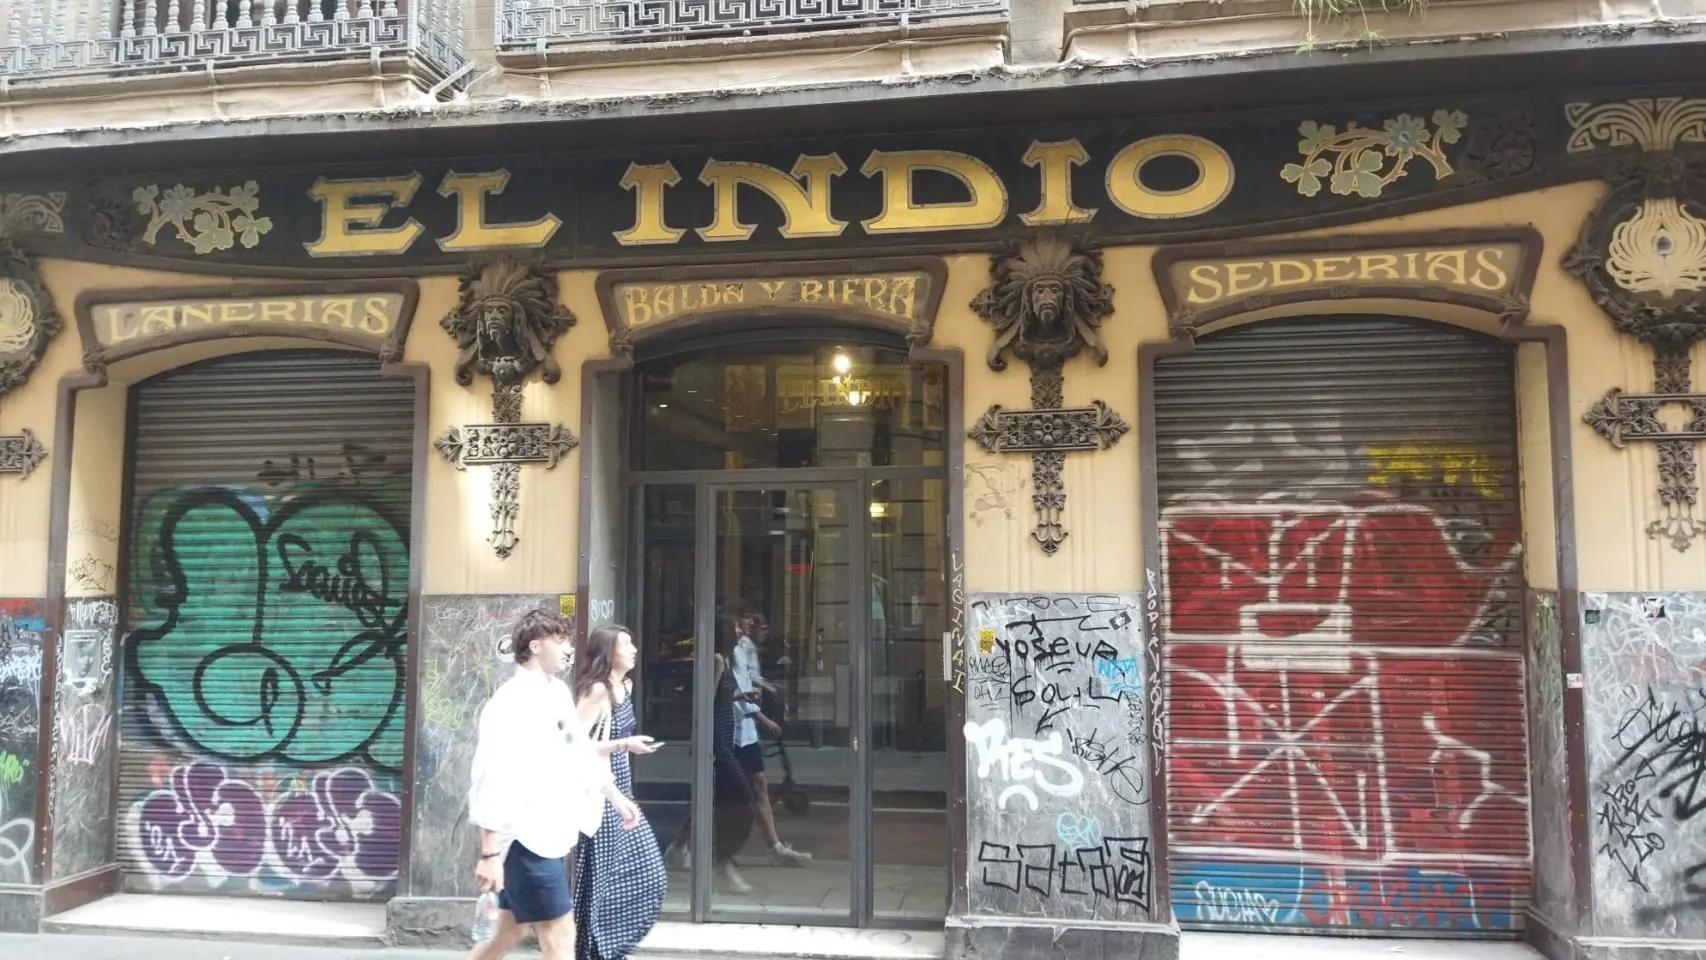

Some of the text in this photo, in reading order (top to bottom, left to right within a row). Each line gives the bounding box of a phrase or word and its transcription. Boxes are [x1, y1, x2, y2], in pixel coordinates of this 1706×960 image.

[302, 134, 1235, 258] EL INDIO
[757, 281, 785, 300] Y
[1187, 248, 1508, 304] SEDERIAS
[108, 295, 392, 346] LANERIAS
